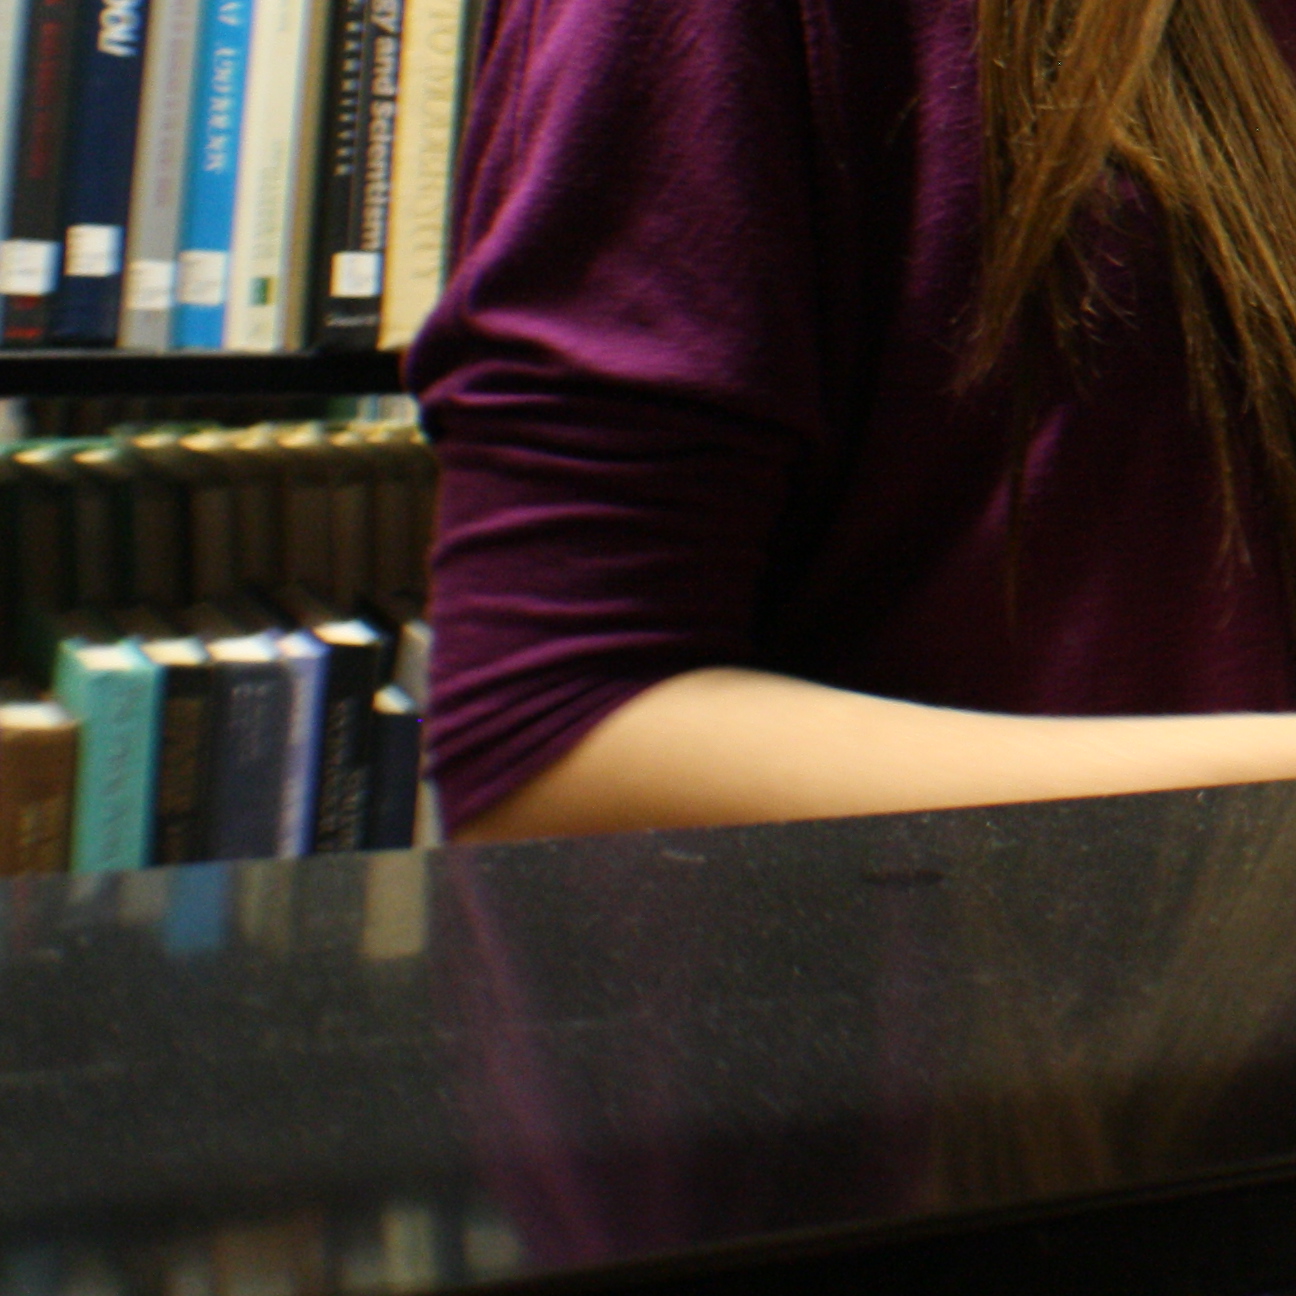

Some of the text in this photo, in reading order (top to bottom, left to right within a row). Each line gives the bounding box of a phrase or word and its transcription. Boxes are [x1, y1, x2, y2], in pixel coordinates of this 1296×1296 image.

[371, 35, 398, 96] and
[426, 7, 460, 55] TO
[360, 98, 396, 251] Scientism
[411, 65, 456, 280] MODERNITY
